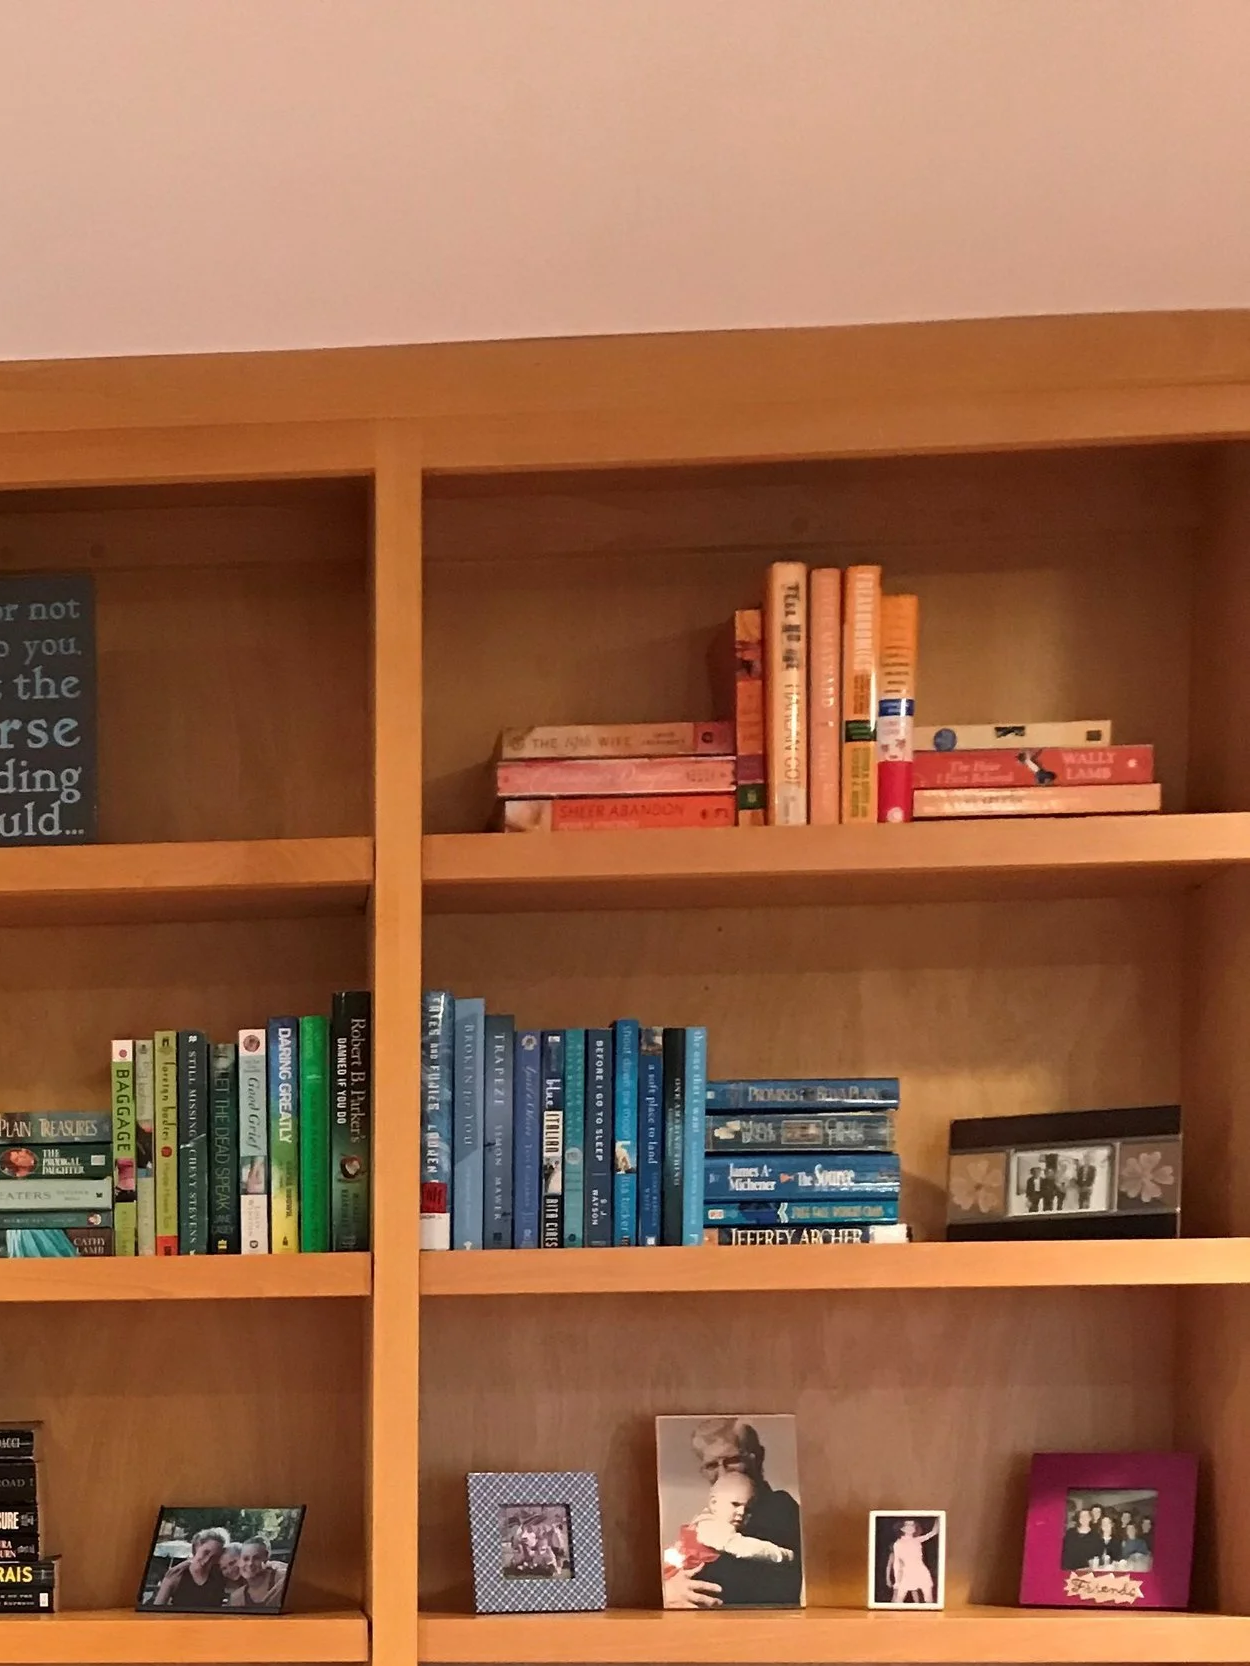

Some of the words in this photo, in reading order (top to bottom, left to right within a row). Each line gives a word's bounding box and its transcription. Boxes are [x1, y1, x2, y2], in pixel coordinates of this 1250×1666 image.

[28, 598, 81, 620] not
[12, 665, 82, 700] the
[1061, 751, 1116, 765] WALLY
[1066, 766, 1112, 781] LAMB
[558, 804, 606, 819] SHEER
[610, 802, 686, 818] ABANDON
[278, 1027, 292, 1081] DARING
[336, 1038, 347, 1076] DAMNED
[350, 1018, 366, 1066] Robert
[188, 1050, 197, 1084] STILL
[595, 1040, 604, 1080] BEFORE
[213, 1069, 230, 1093] LET
[337, 1078, 347, 1087] IF
[350, 1071, 364, 1086] B.
[116, 1069, 131, 1152] BAGGAGE
[188, 1088, 198, 1137] MISSING
[214, 1097, 230, 1124] THE
[279, 1083, 292, 1143] GREATLY
[336, 1090, 347, 1109] YOU
[350, 1090, 366, 1143] Parker's
[595, 1092, 603, 1107] GO
[336, 1111, 347, 1125] DO
[595, 1111, 603, 1125] TO
[215, 1127, 230, 1164] DEAD
[595, 1128, 604, 1162] SLEEP
[188, 1149, 198, 1188] CHEVY
[215, 1167, 231, 1211] SPEAK
[188, 1192, 199, 1244] STEVENS
[730, 1227, 796, 1245] JEFFREY
[800, 1228, 863, 1245] ARCHER
[1071, 1578, 1136, 1597] Friends
